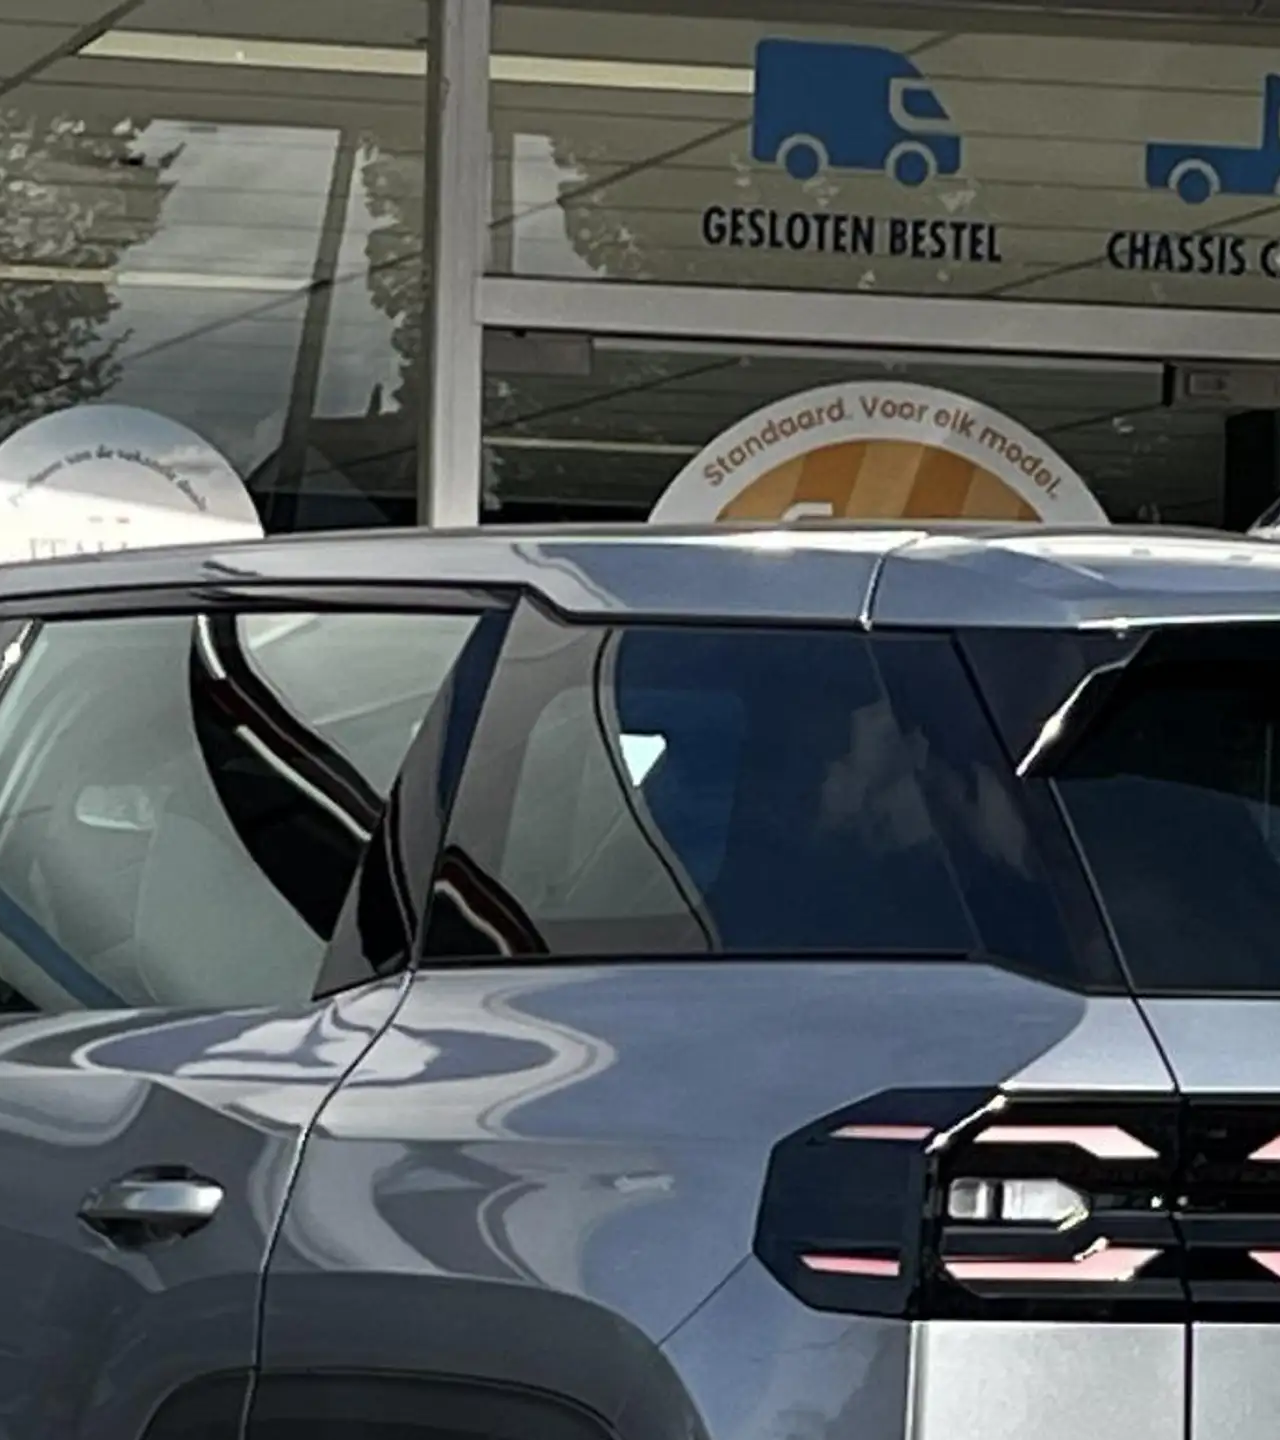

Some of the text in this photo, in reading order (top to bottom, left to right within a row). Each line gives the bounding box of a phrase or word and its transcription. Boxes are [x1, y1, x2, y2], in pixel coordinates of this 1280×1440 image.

[702, 206, 1002, 263] GESLOTEN BESTEL
[1106, 231, 1246, 276] CHASSIS
[859, 396, 929, 423] Voor
[934, 408, 975, 439] elk
